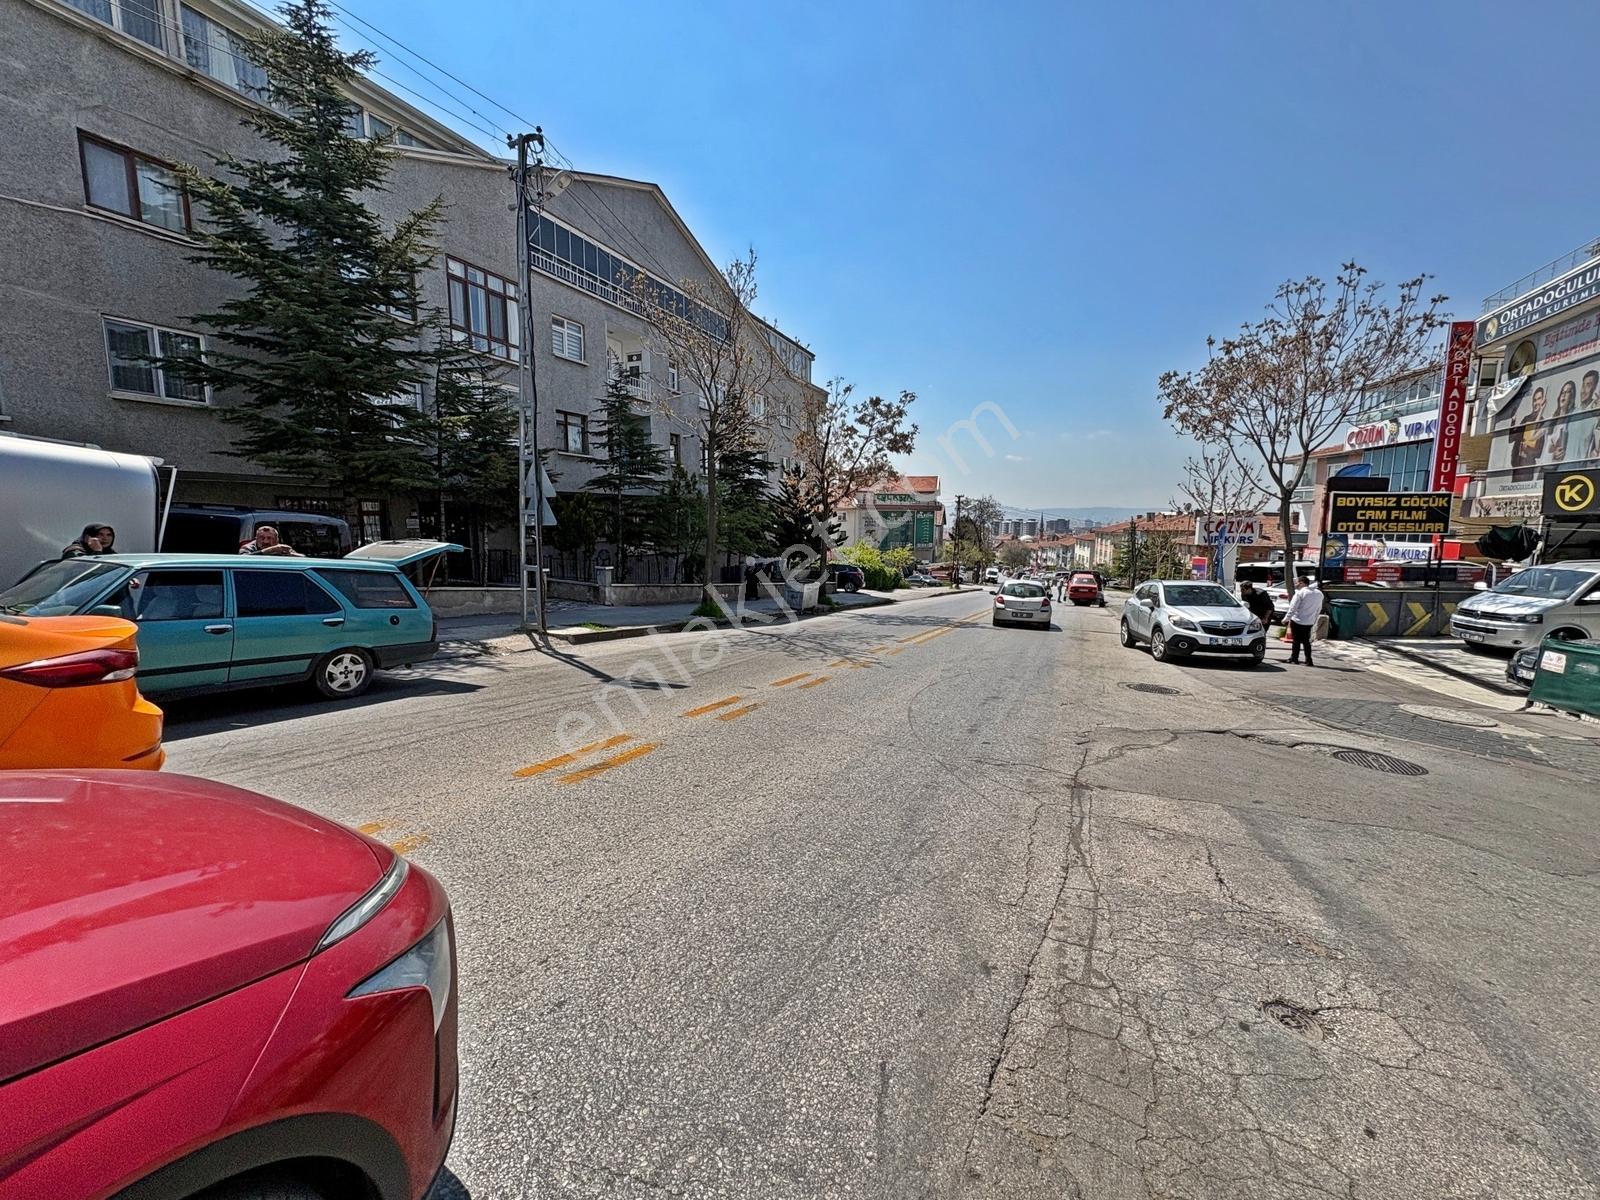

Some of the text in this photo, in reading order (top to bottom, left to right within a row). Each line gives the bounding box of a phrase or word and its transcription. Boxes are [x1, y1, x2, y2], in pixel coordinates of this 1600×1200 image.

[1502, 286, 1600, 335] EĞİTİM KURUML
[1404, 421, 1423, 437] VIP
[1336, 495, 1449, 509] BOYASIZ GÖÇÜK
[1356, 510, 1387, 520] CAM
[1337, 522, 1445, 532] OTO AKSESUAR
[1224, 535, 1254, 544] KURS
[1386, 547, 1400, 558] VIP
[1401, 548, 1427, 560] KURS
